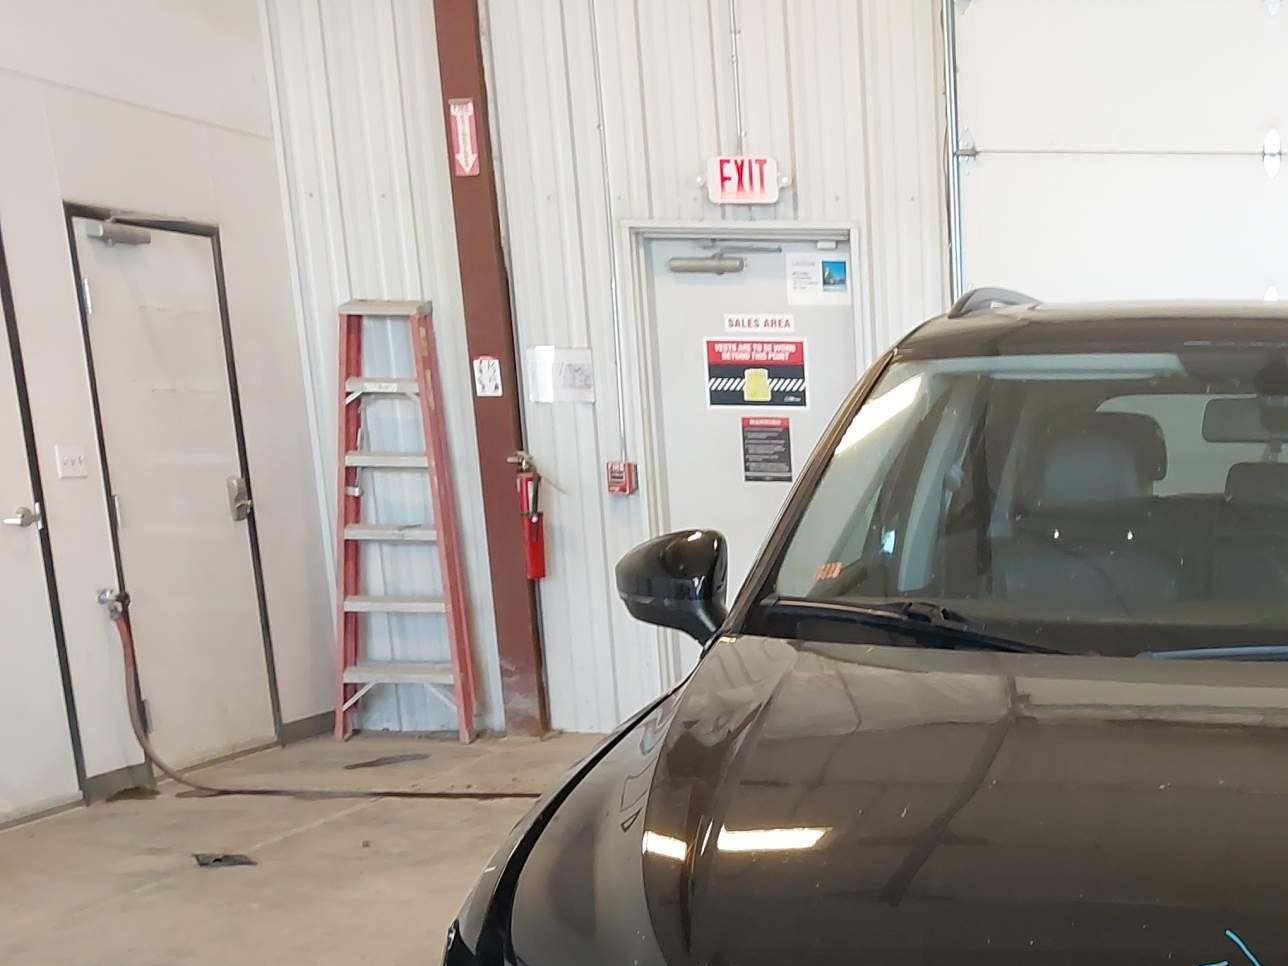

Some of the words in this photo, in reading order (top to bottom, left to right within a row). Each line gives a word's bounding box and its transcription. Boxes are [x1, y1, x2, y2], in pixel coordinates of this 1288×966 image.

[719, 159, 767, 195] EXIT
[727, 318, 760, 328] SALES
[763, 319, 791, 328] AREA
